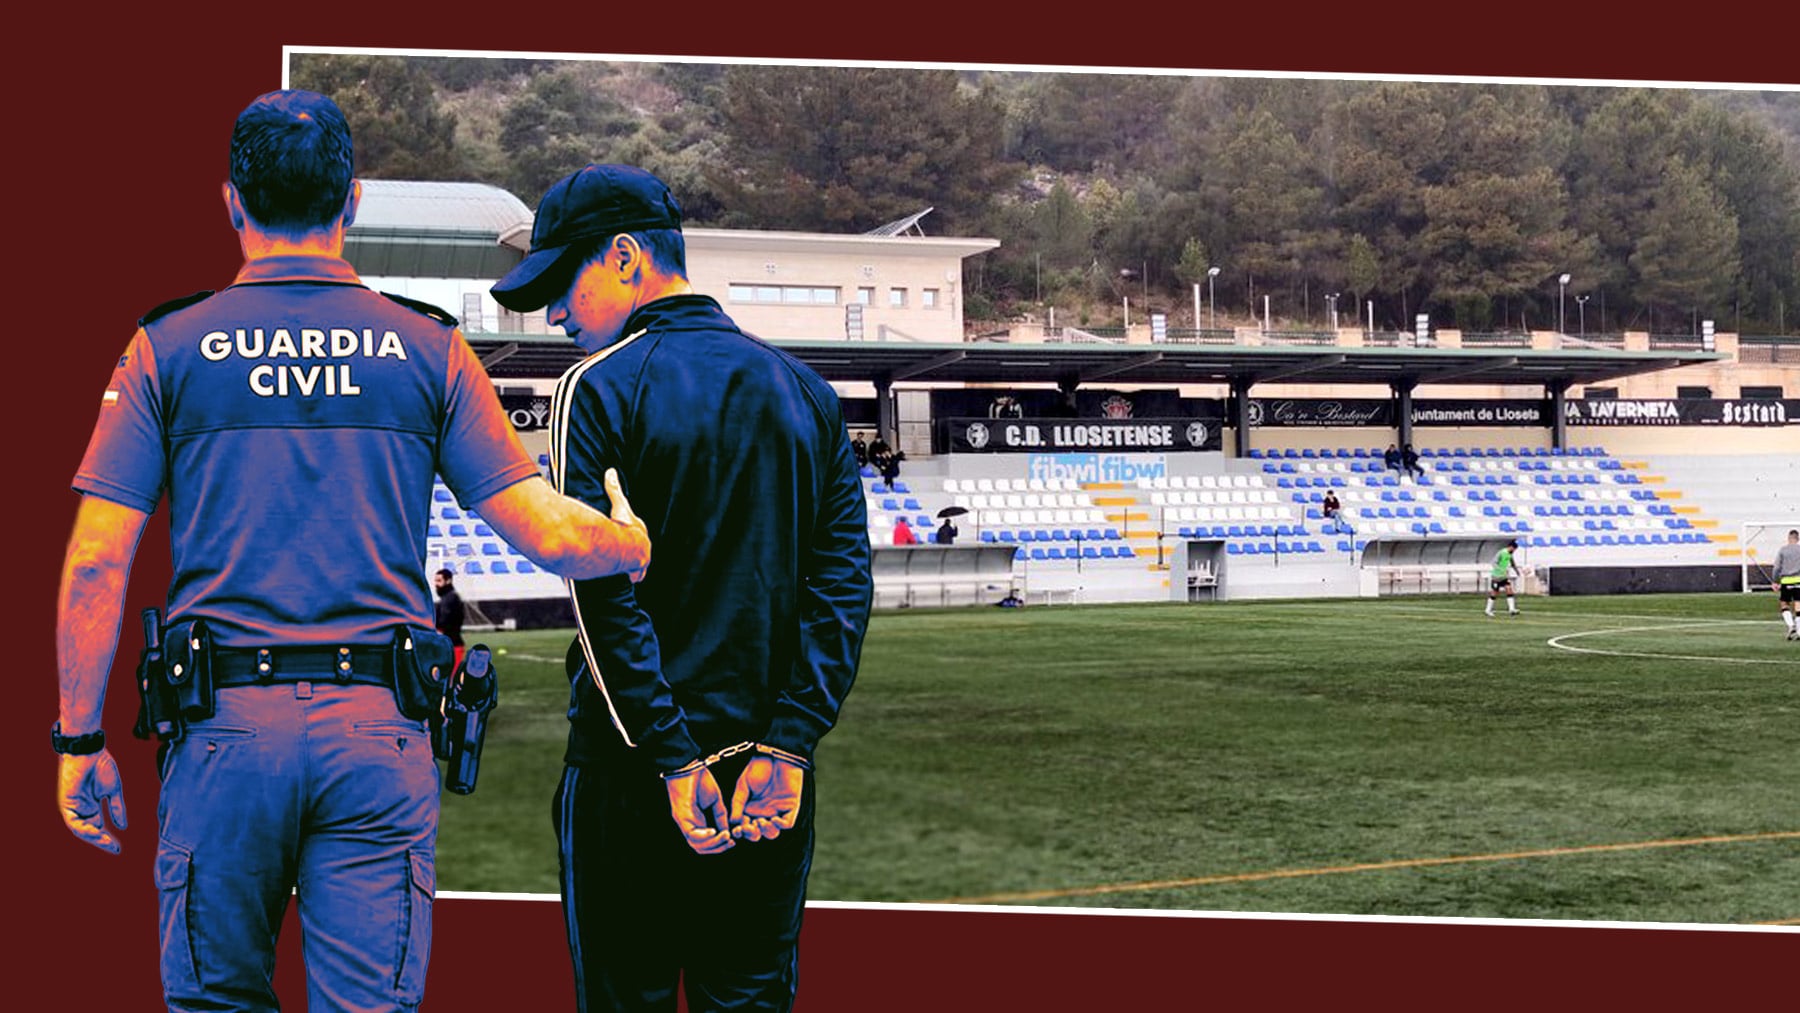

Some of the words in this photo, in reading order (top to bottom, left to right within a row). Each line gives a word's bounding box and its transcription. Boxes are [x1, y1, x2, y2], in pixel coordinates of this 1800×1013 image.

[199, 329, 408, 361] GUARDIA
[249, 365, 361, 396] CIVIL
[1477, 409, 1493, 420] de
[1496, 409, 1540, 420] Lloseta
[1588, 402, 1679, 417] TAVERNETA
[1722, 402, 1786, 423] Bestard
[1005, 426, 1046, 446] C.D.
[1054, 425, 1173, 446] LLOSETENSE
[1030, 456, 1097, 482] fibwi
[1103, 456, 1165, 482] fibwi
